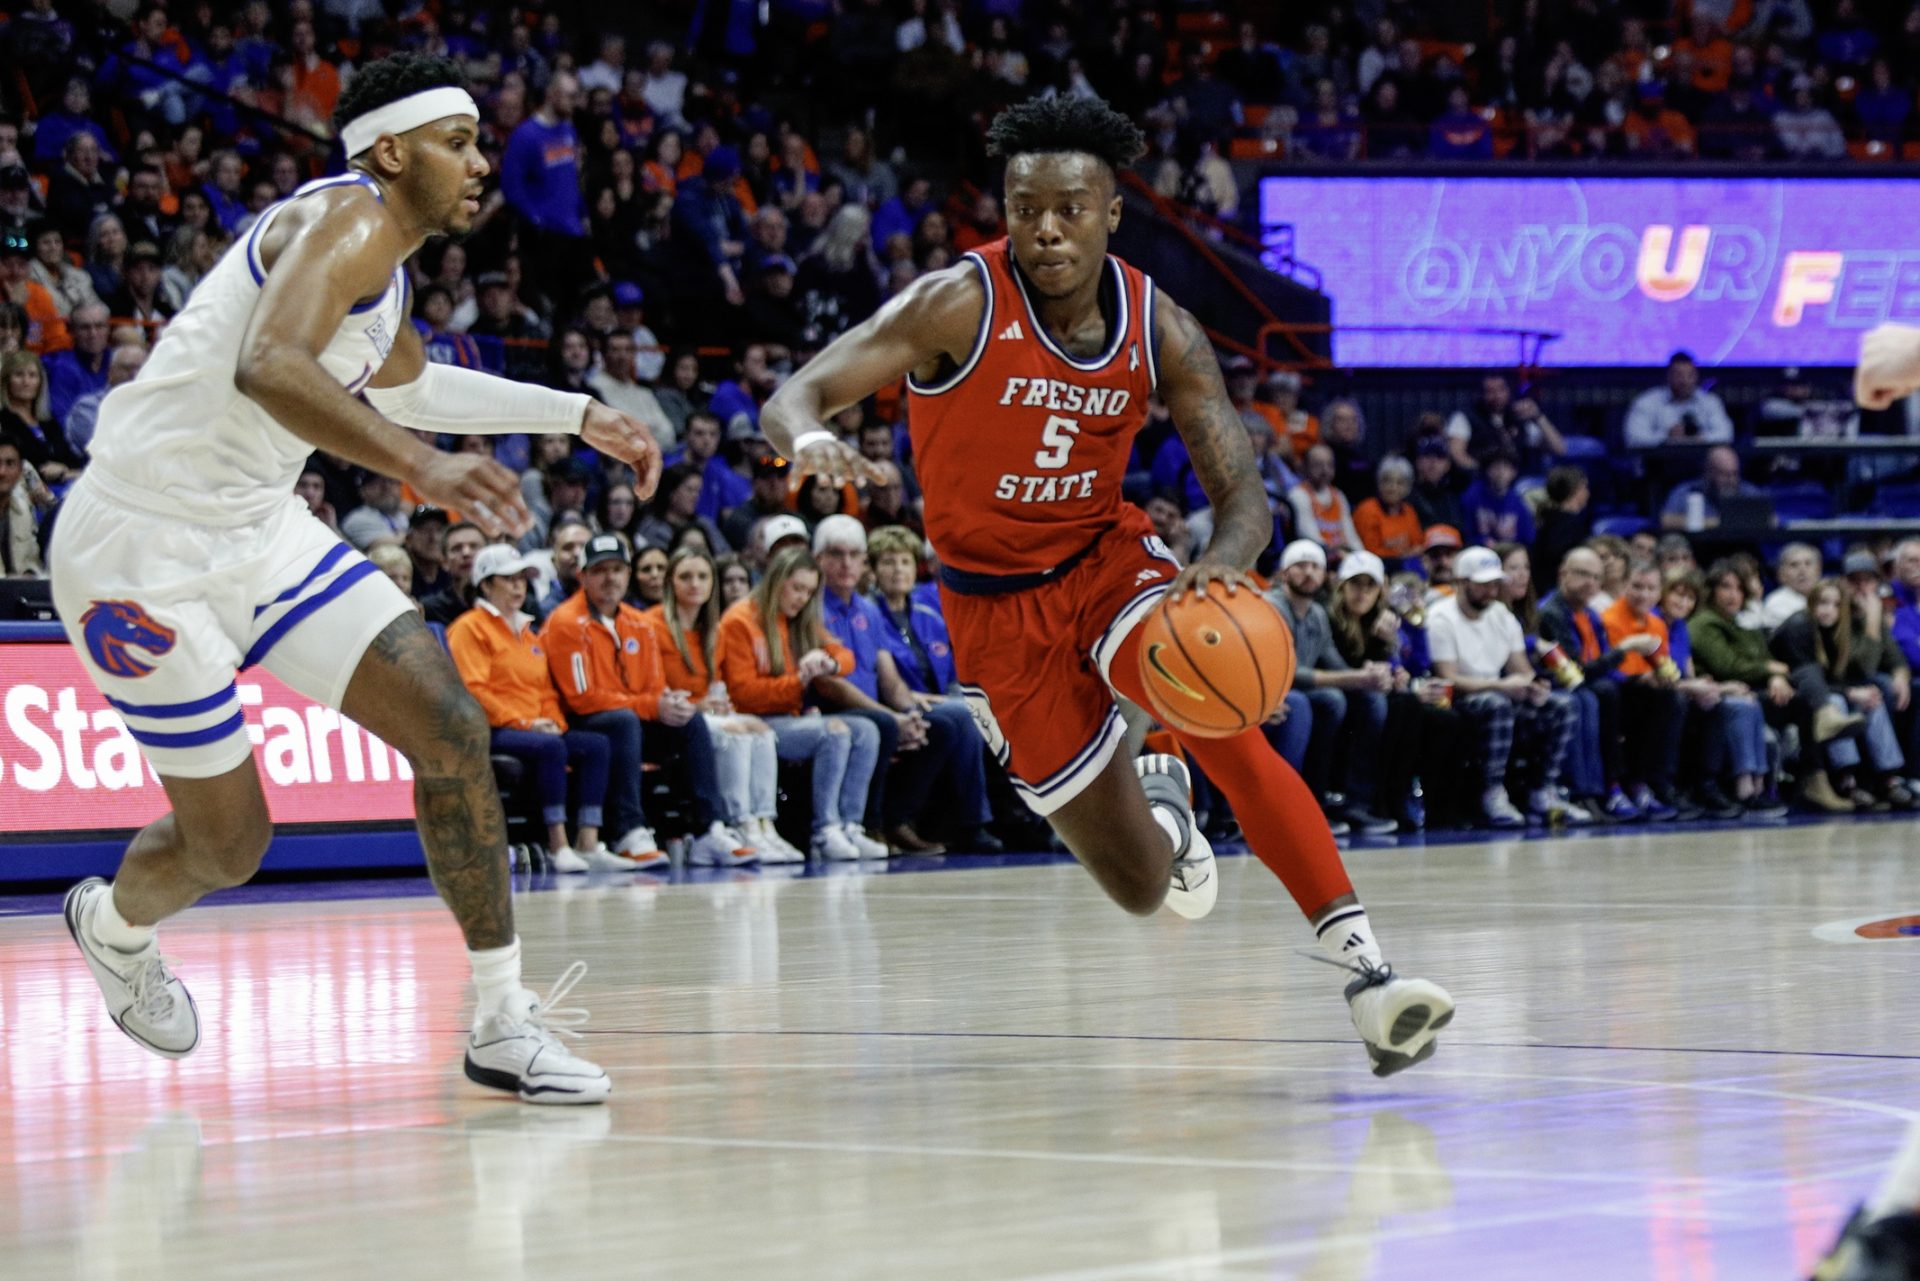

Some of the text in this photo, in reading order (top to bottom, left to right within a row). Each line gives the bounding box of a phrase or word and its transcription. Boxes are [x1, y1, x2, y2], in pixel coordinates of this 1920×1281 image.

[1517, 222, 1766, 303] YOUR
[999, 377, 1131, 416] FRESNO
[1034, 414, 1080, 469] 5
[995, 469, 1098, 502] STATE
[4, 684, 163, 792] Sta
